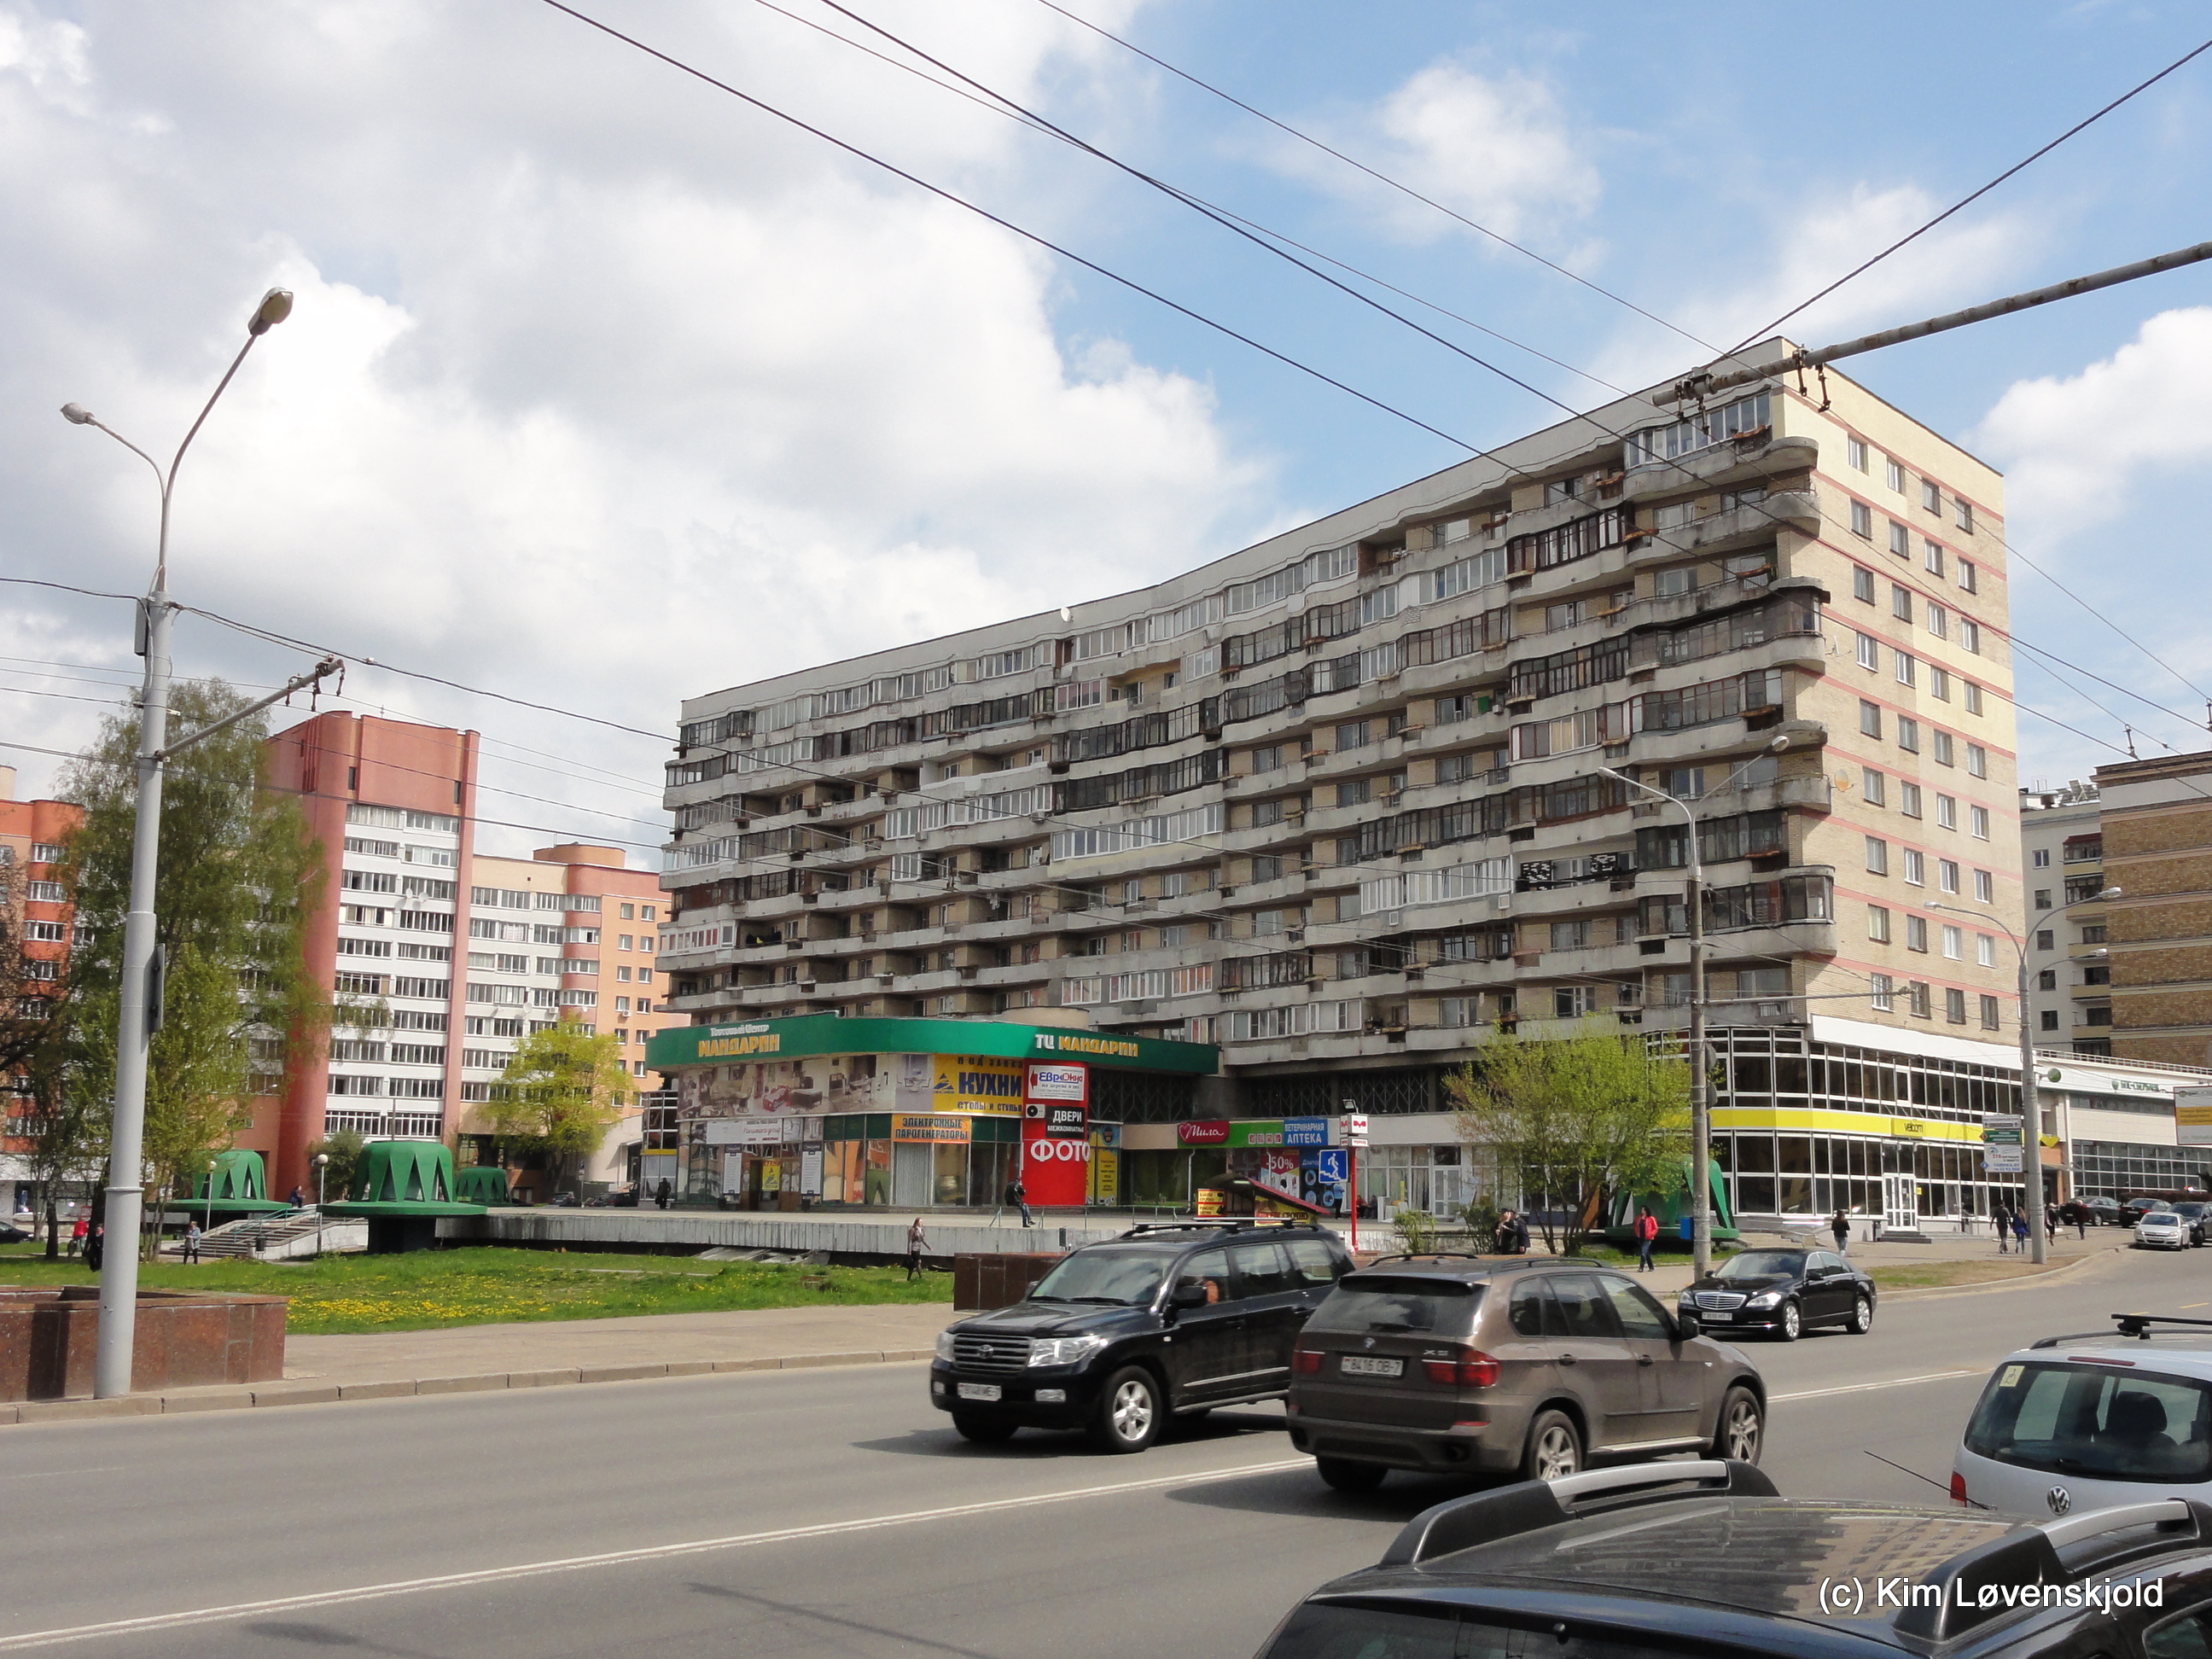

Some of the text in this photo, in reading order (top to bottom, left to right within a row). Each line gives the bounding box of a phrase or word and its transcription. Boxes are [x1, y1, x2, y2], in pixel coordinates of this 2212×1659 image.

[698, 1033, 780, 1057] МАНДАРИН
[1034, 1033, 1138, 1057] ТЦ МАНДАРИН
[958, 1072, 1022, 1097] КУХНИ
[957, 1101, 987, 1110] СТОЛЫ
[997, 1103, 1022, 1112] СТУЛЬЯ
[902, 1117, 963, 1128] ЭЛЕКТРОННЫЕ
[1052, 1110, 1082, 1123] ДВЕРИ
[1185, 1124, 1225, 1139] Мила
[1284, 1122, 1324, 1132] ВЕТЕРИНАРНАЯ
[1904, 1122, 1924, 1132] velcom
[895, 1128, 969, 1139] ПАРОГЕНЕРАТОРЫ
[1287, 1133, 1322, 1144] АПТЕКА
[1030, 1139, 1091, 1161] ФОТО
